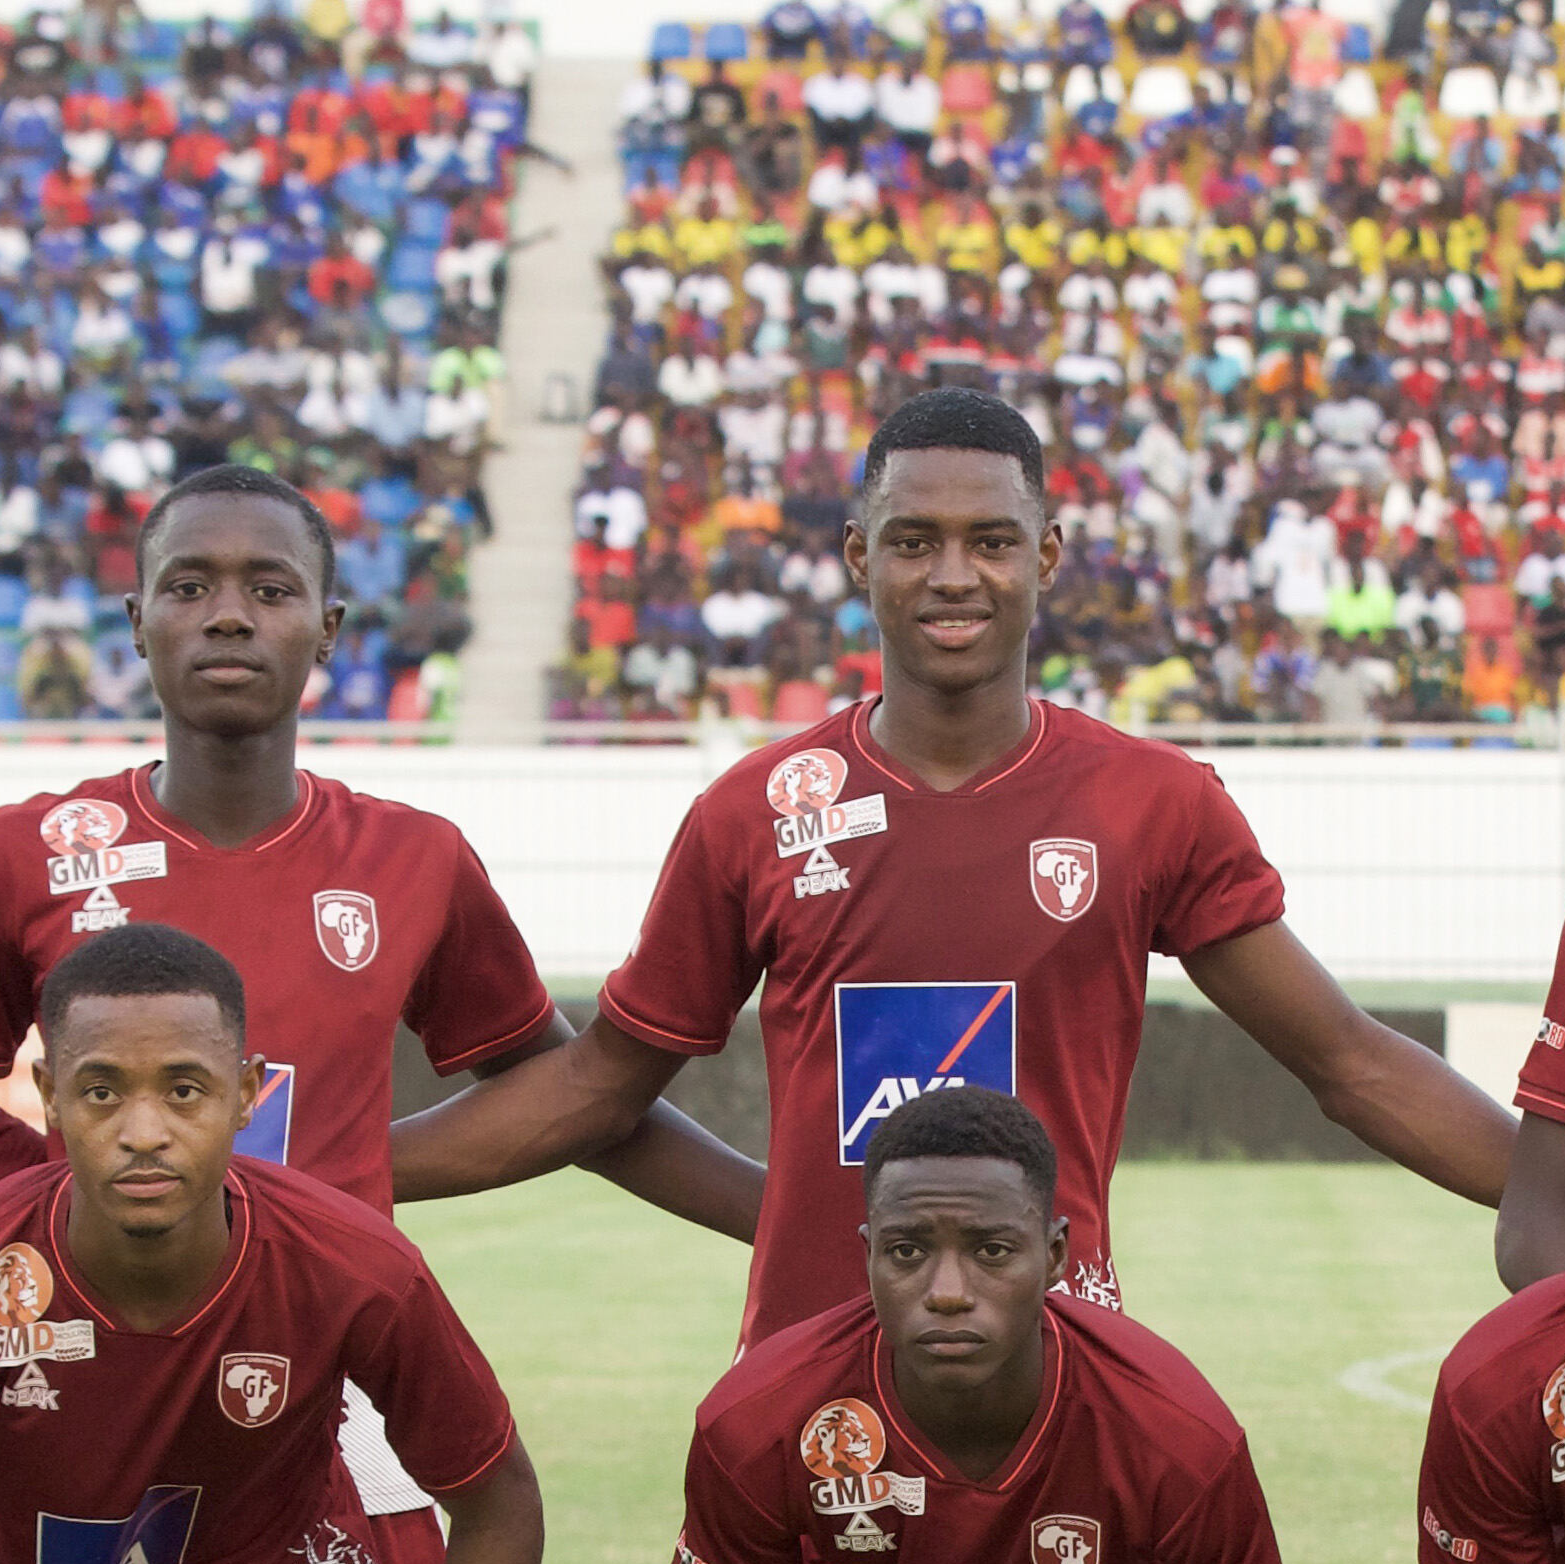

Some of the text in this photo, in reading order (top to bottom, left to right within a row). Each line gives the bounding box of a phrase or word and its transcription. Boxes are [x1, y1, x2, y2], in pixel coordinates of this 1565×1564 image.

[776, 806, 846, 848] GMD
[51, 849, 124, 885] GMD
[1054, 861, 1078, 886] GF
[793, 867, 850, 898] PEAK
[72, 908, 131, 932] PEAK
[338, 912, 361, 937] GF
[1, 1386, 60, 1410] PEAK
[243, 1375, 269, 1398] GF
[811, 1474, 891, 1509] GMD
[834, 1533, 897, 1552] PEAK
[1055, 1535, 1081, 1558] GF
